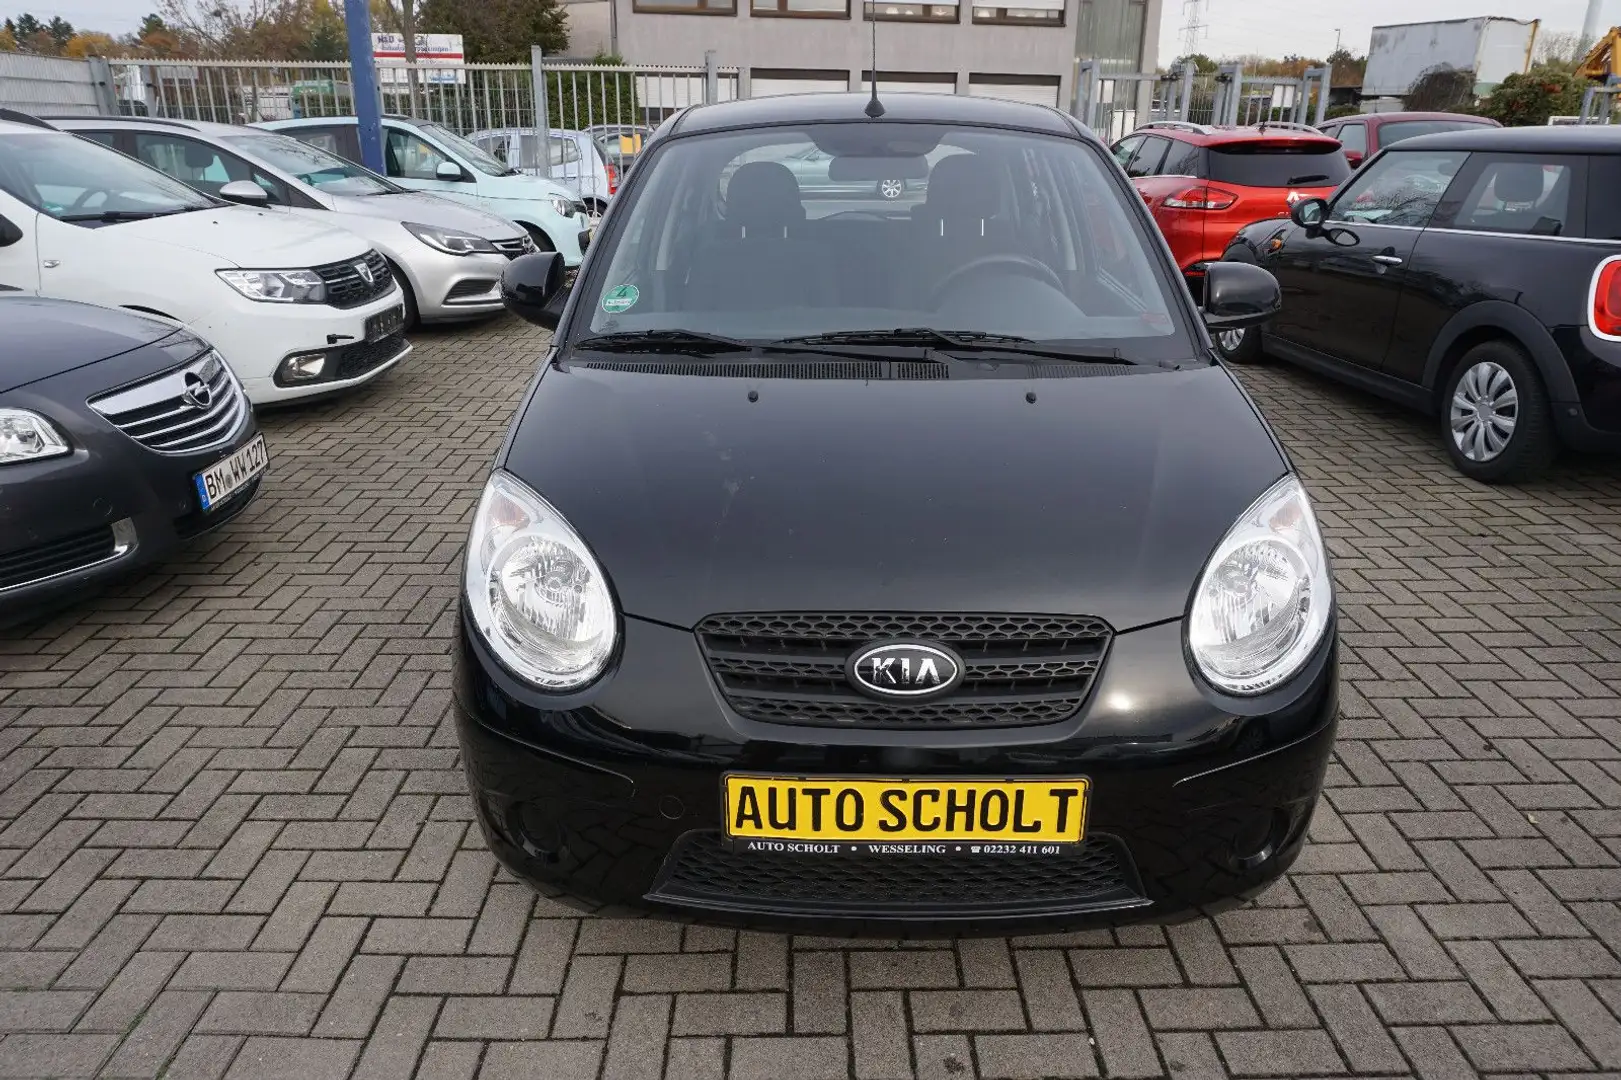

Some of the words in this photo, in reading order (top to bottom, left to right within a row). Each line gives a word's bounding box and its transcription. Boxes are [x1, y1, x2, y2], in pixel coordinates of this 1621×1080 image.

[615, 286, 628, 298] 4
[205, 467, 227, 499] BM
[229, 452, 248, 484] WW
[246, 440, 264, 472] 127
[871, 657, 941, 685] KIA
[735, 785, 865, 832] AUTO
[878, 788, 1079, 833] SCHOLT
[747, 841, 785, 852] AUTO
[787, 843, 841, 854] SCHOLT
[868, 844, 947, 855] WESSELING
[983, 845, 1017, 855] 02232
[1019, 846, 1038, 855] 411
[1041, 846, 1061, 855] 601
